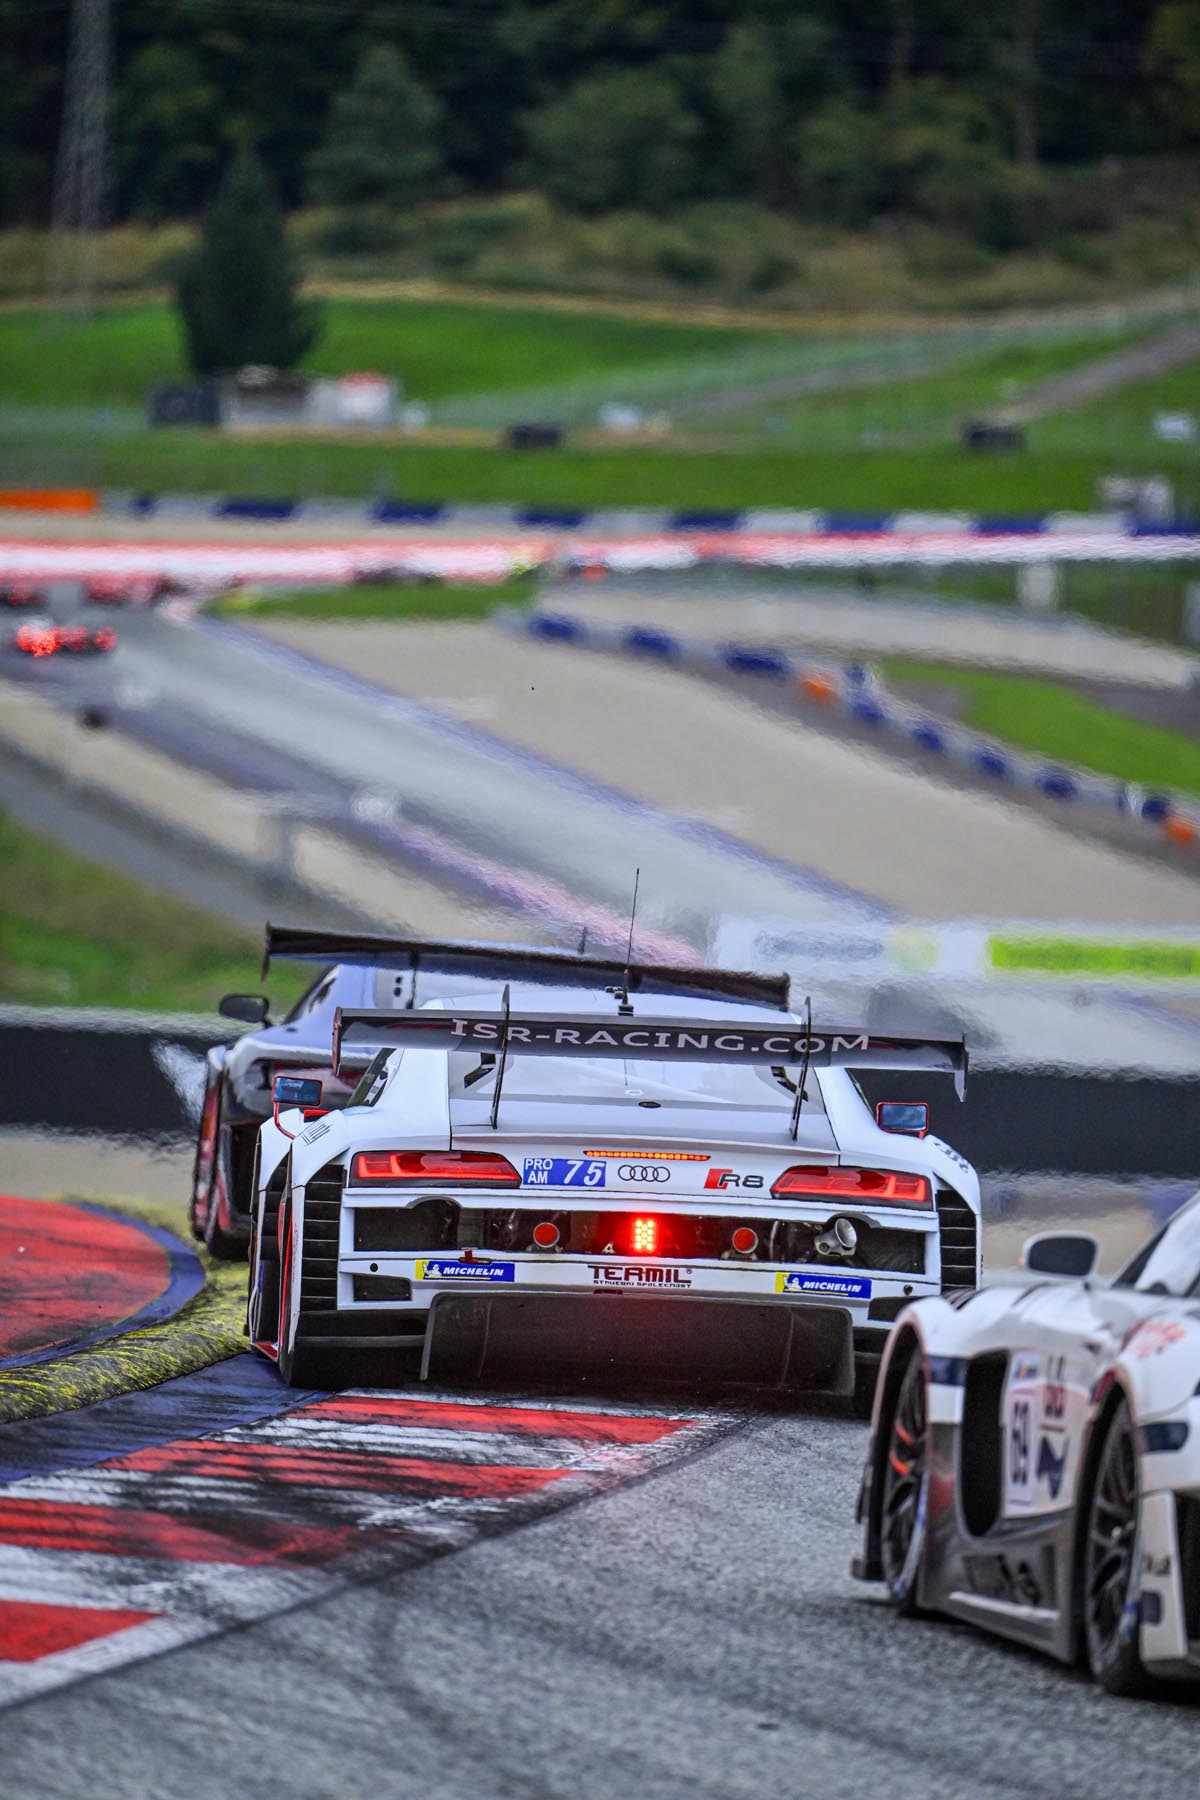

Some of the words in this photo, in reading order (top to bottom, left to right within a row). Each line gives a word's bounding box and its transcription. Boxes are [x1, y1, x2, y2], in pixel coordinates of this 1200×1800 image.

[450, 1017, 870, 1054] ISR-RACING.COM
[524, 1158, 554, 1171] PRO
[526, 1171, 549, 1184] AM
[562, 1160, 606, 1187] 75
[717, 1172, 765, 1189] R8
[442, 1266, 505, 1277] MICHELIN
[802, 1280, 862, 1293] MICHELIN
